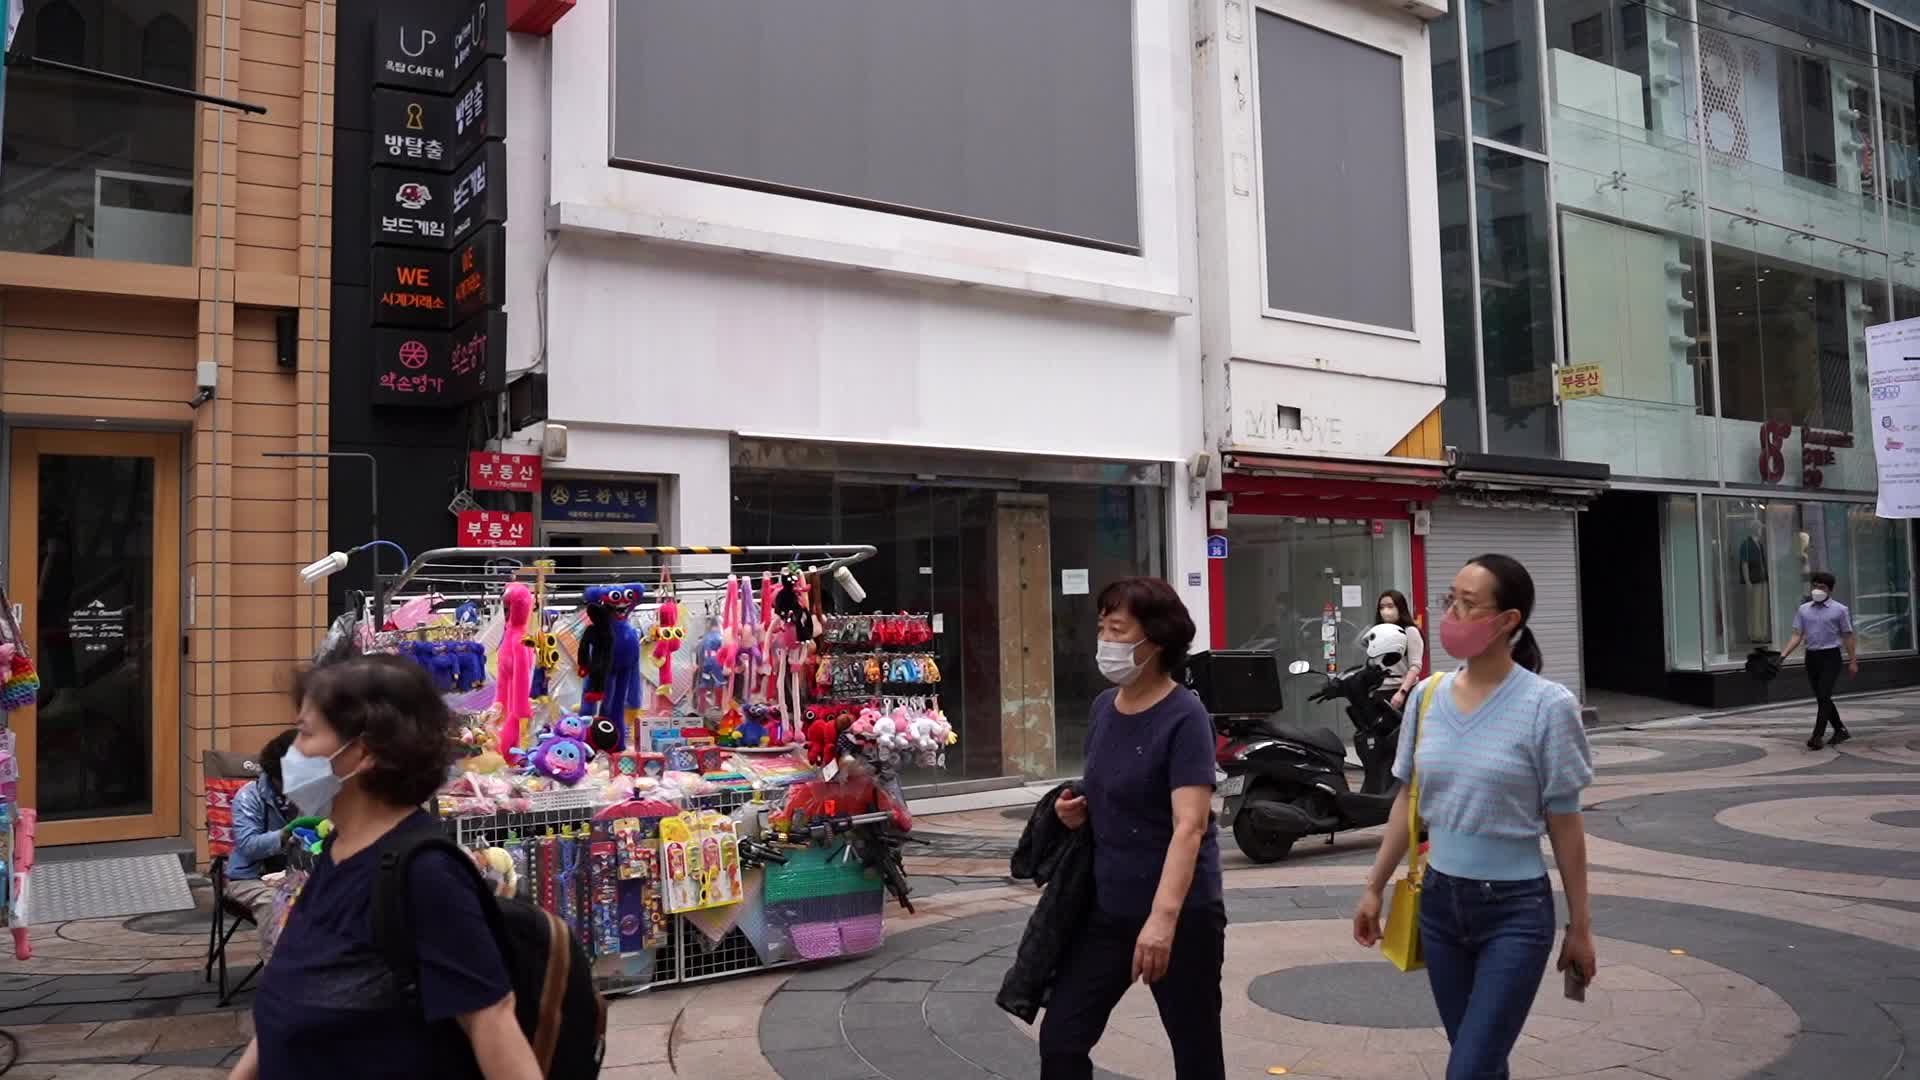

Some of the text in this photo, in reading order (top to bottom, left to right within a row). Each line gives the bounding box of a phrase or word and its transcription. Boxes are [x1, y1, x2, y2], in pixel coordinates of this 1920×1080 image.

[400, 26, 436, 57] UP
[408, 64, 433, 77] CAFE
[435, 68, 444, 79] M
[384, 134, 444, 160] 방탈출
[382, 215, 445, 238] 보드게임
[397, 266, 431, 287] WE
[379, 371, 445, 393] 약손명가
[1561, 371, 1599, 389] 부동산
[479, 463, 534, 481] 부동산
[467, 522, 524, 538] 부동산
